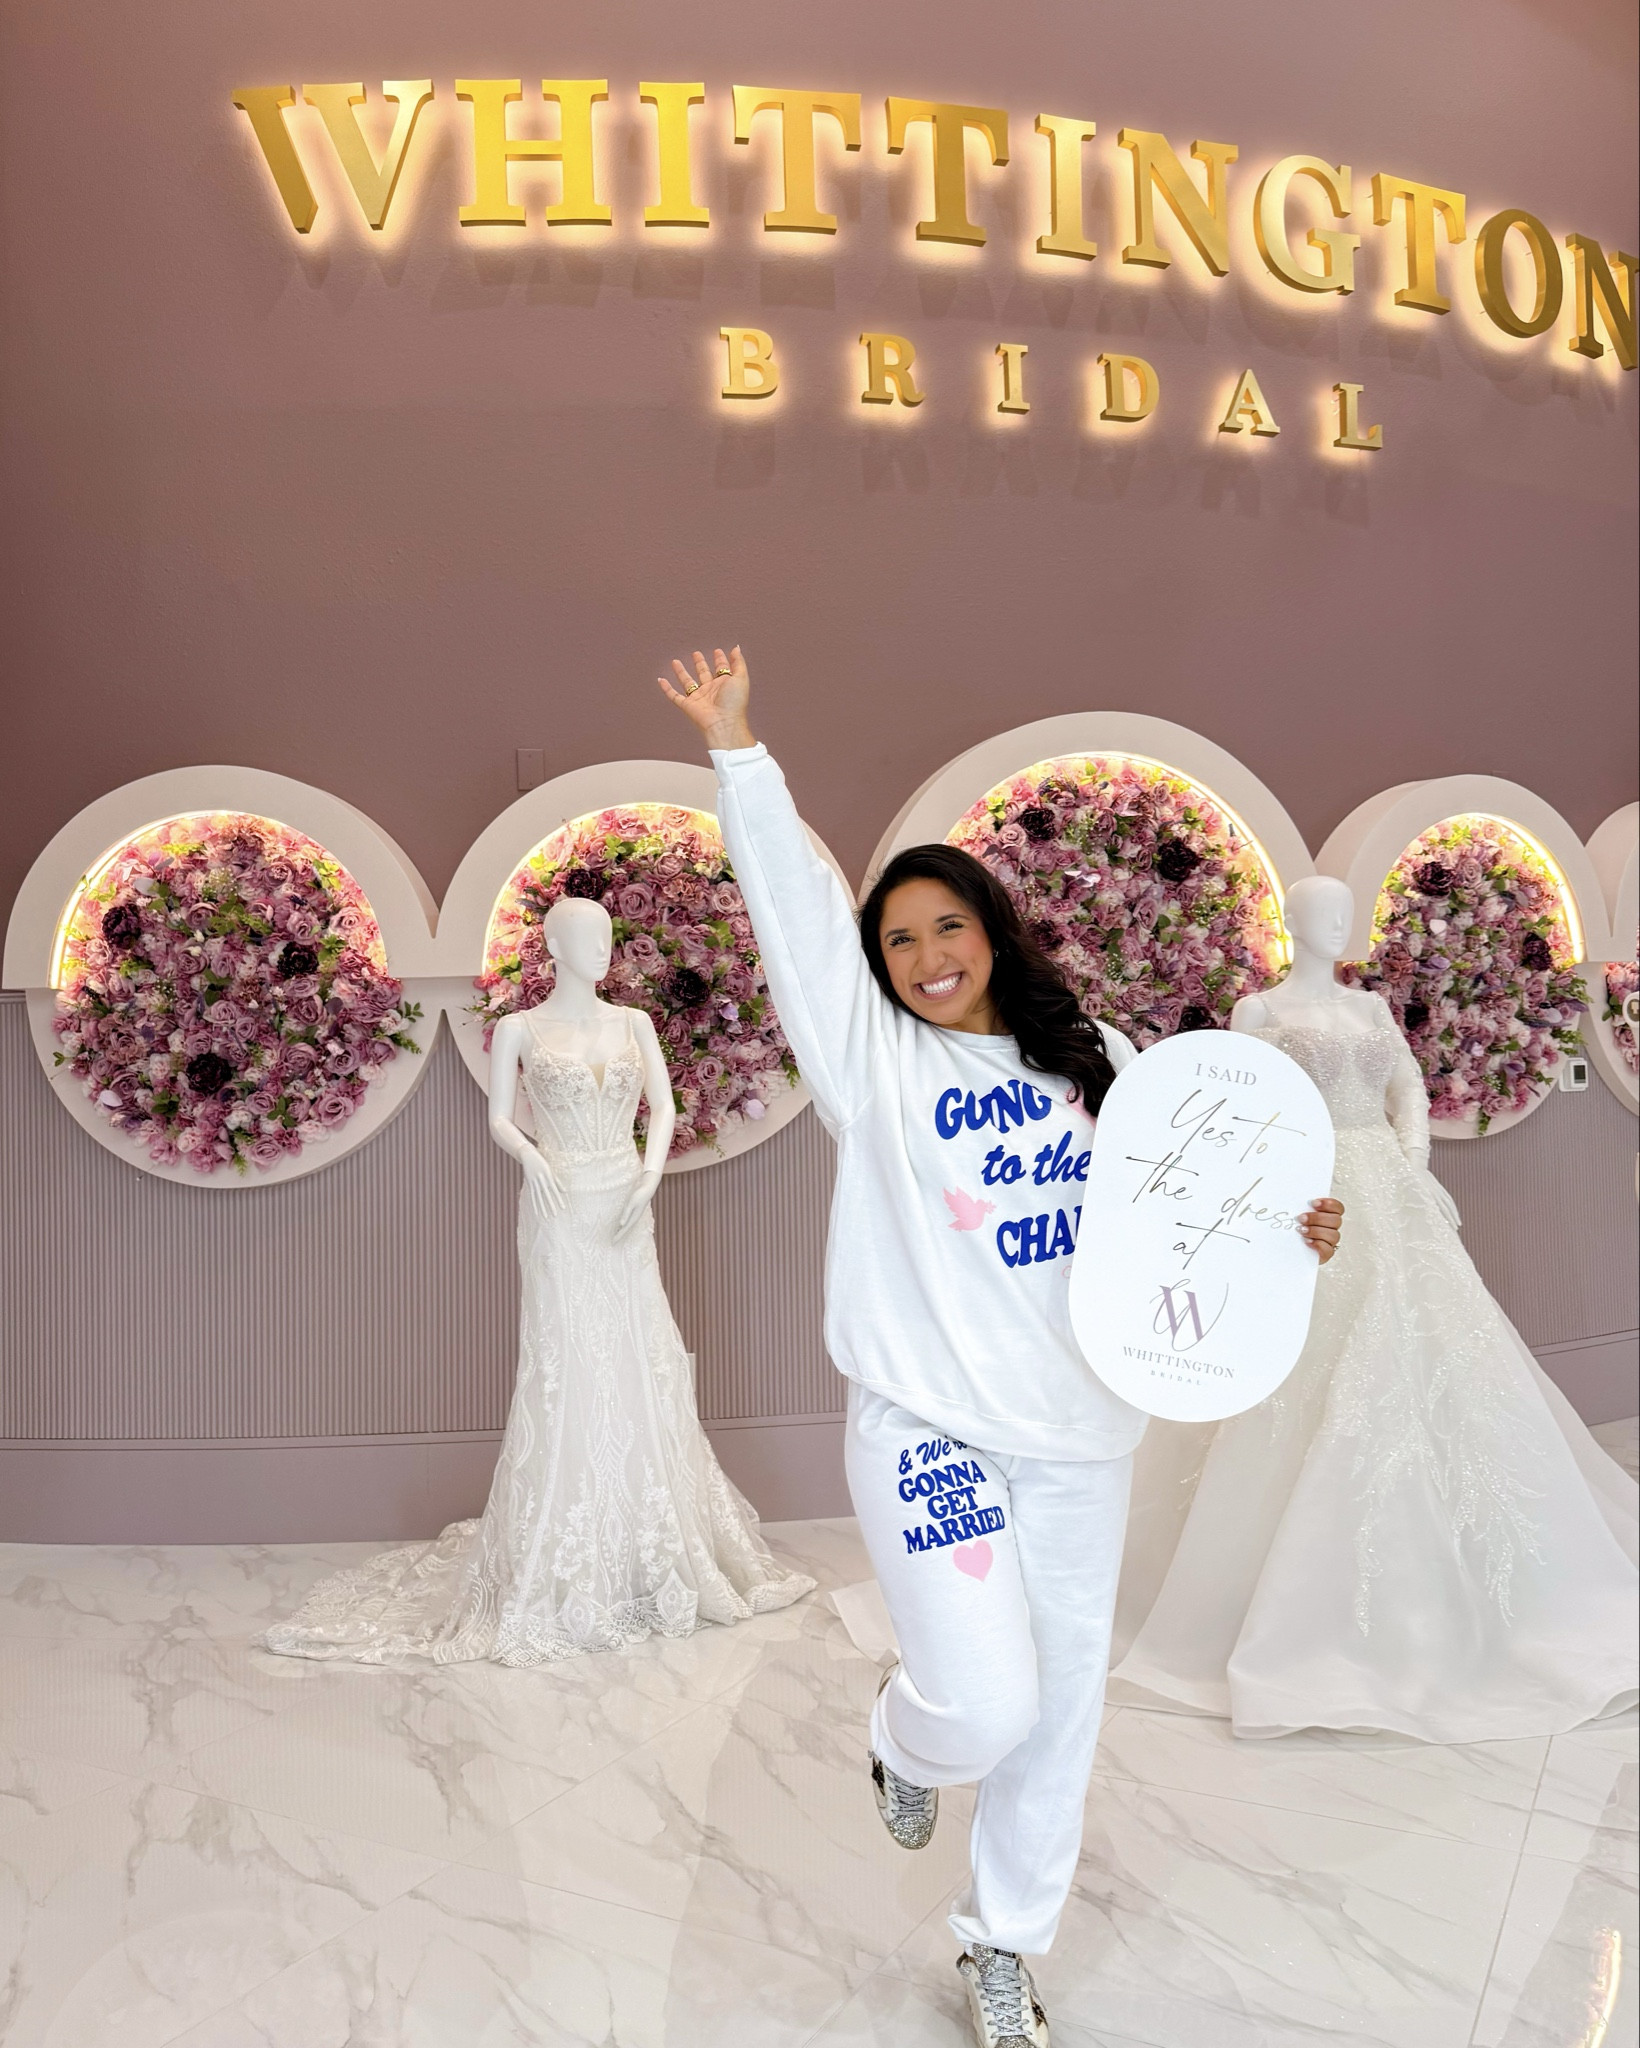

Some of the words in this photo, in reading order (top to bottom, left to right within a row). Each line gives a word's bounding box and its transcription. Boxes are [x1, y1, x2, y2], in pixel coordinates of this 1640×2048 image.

[232, 79, 1638, 371] WHITTINGTON
[719, 326, 1383, 450] BRIDAL
[1194, 1062, 1203, 1077] I
[1207, 1065, 1258, 1086] SAID
[1171, 1088, 1237, 1154] Yes
[1232, 1111, 1307, 1164] to
[981, 1144, 1027, 1186] to
[1032, 1130, 1092, 1186] the
[1125, 1151, 1200, 1204] the
[1221, 1176, 1299, 1230] dress
[996, 1205, 1083, 1268] CHA
[1172, 1217, 1251, 1270] at
[1123, 1345, 1236, 1379] WHITTINGTON
[1150, 1369, 1202, 1386] BRIDAL
[898, 1448, 914, 1476] &
[898, 1460, 988, 1503] GONNA
[927, 1486, 979, 1520] GET
[902, 1505, 1006, 1555] MARRIED
